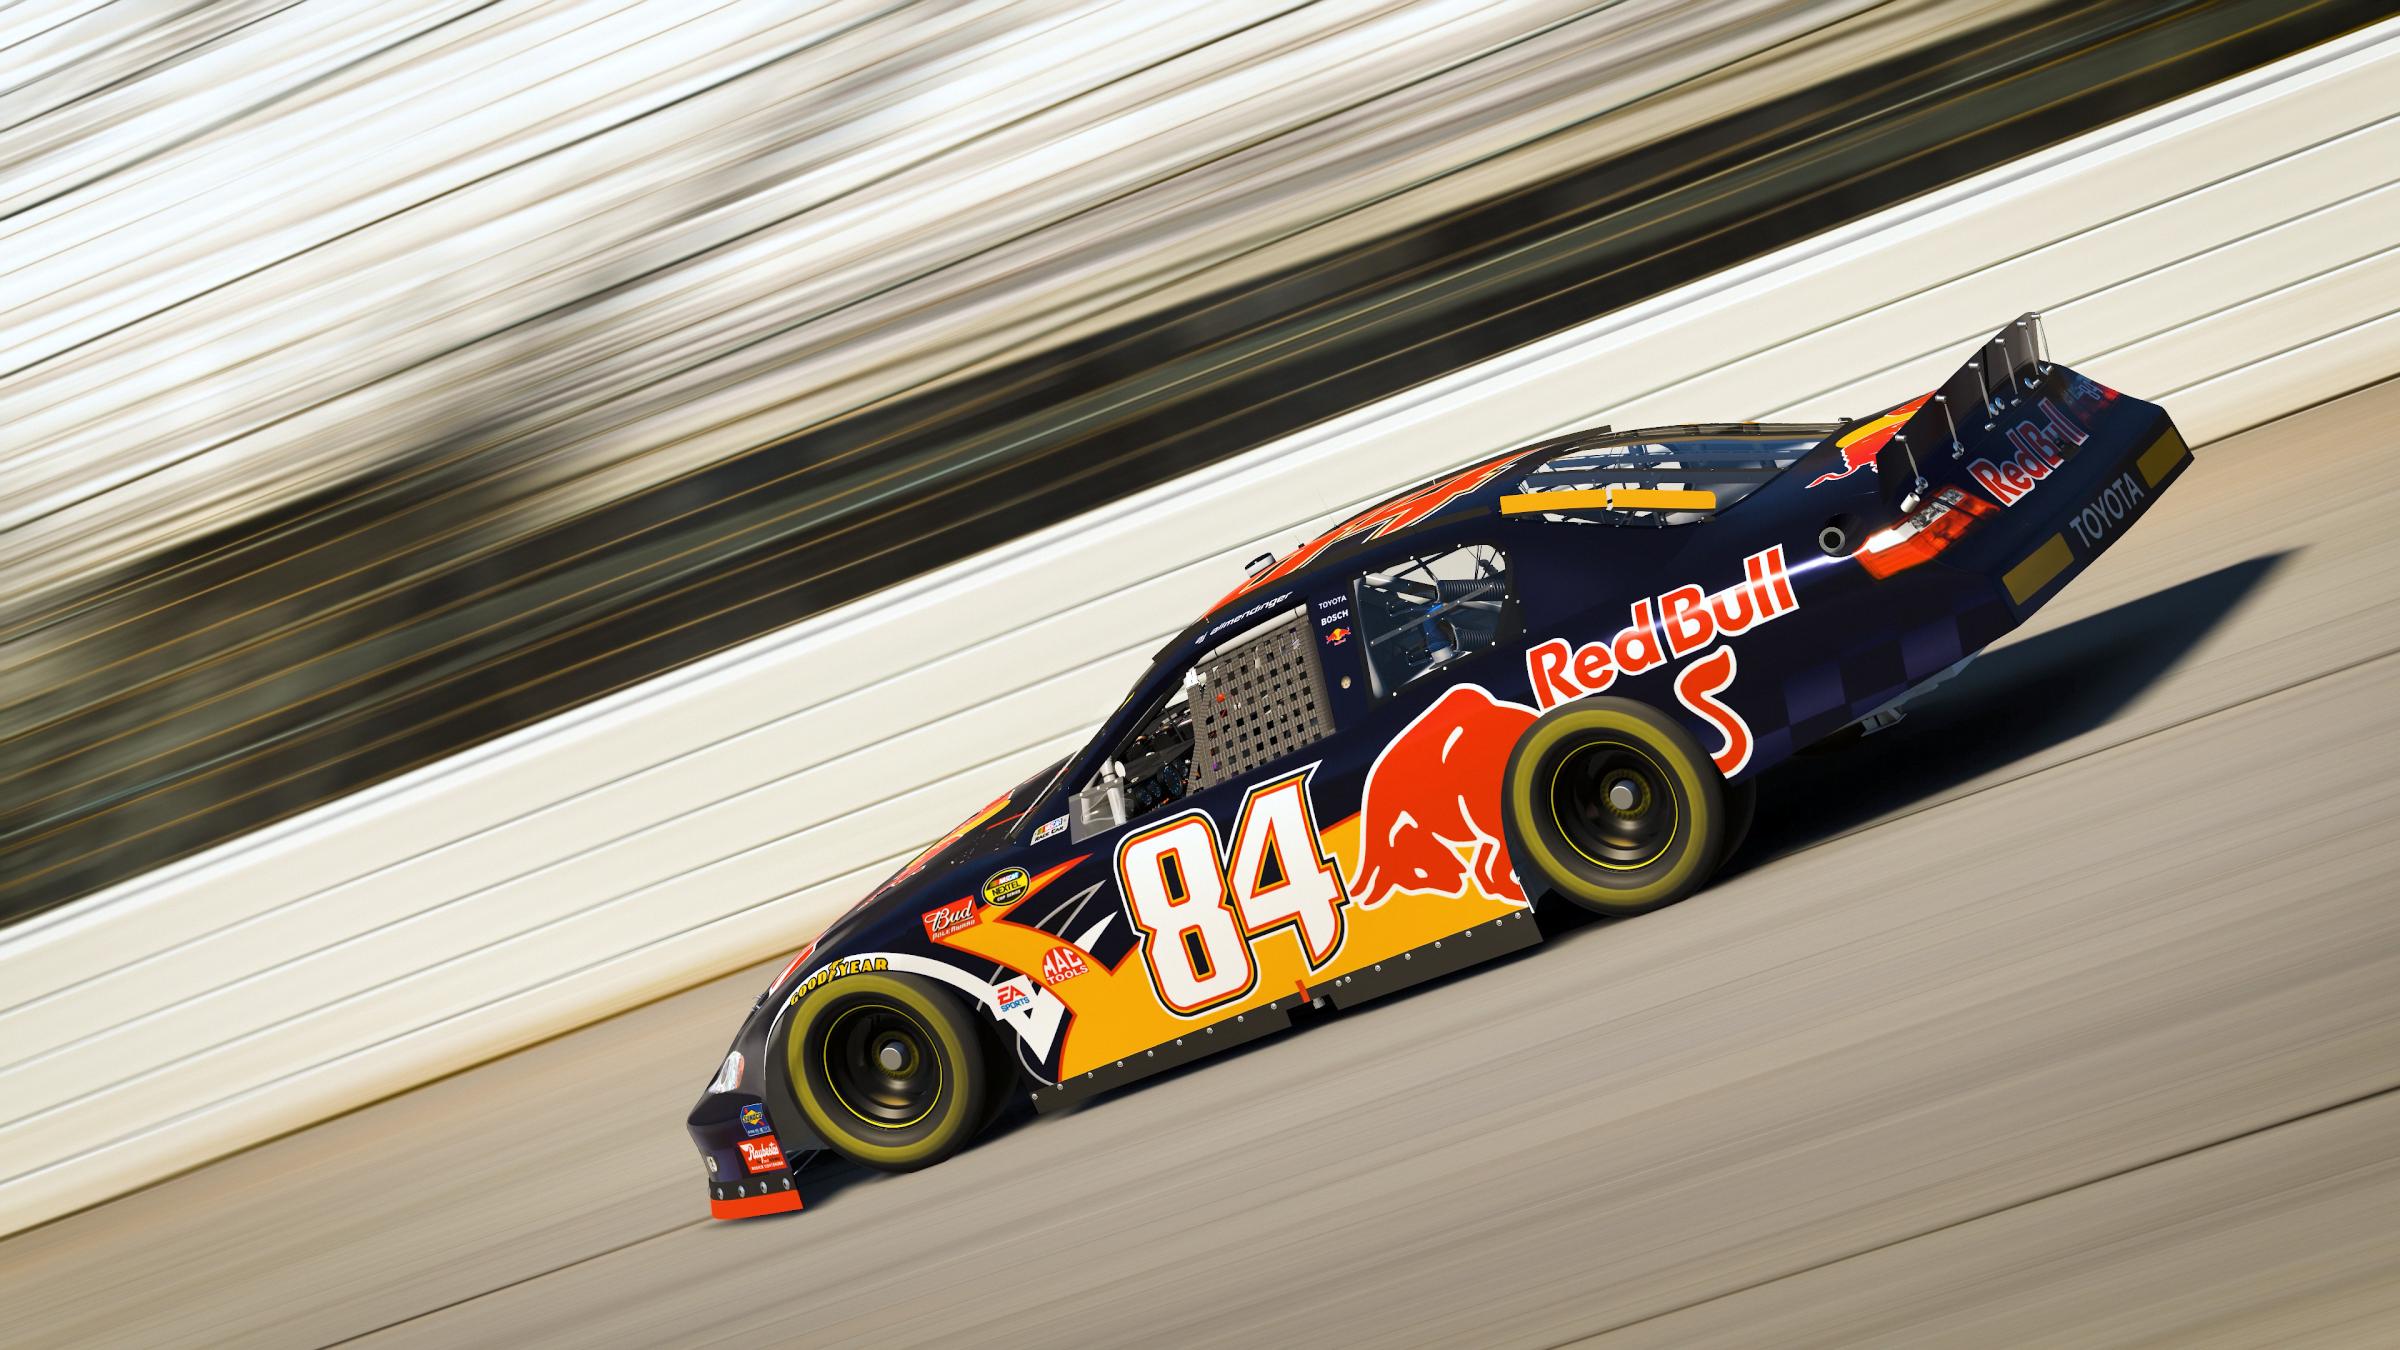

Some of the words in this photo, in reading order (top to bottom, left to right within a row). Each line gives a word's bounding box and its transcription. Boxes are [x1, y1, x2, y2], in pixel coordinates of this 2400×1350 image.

[1966, 428, 2054, 507] Red
[2069, 472, 2145, 548] TOYOTA
[1318, 594, 1347, 610] TOYOTA
[1320, 608, 1349, 627] BOSCH
[1526, 596, 1668, 713] Red
[1657, 543, 1800, 659] Bull
[991, 880, 1021, 897] NEXTEL
[1113, 759, 1351, 1020] 84
[924, 899, 974, 933] Bud
[1043, 948, 1083, 978] MAC
[1047, 965, 1089, 984] TOOLS
[997, 985, 1026, 1006] EA
[1000, 996, 1030, 1012] SPORTS
